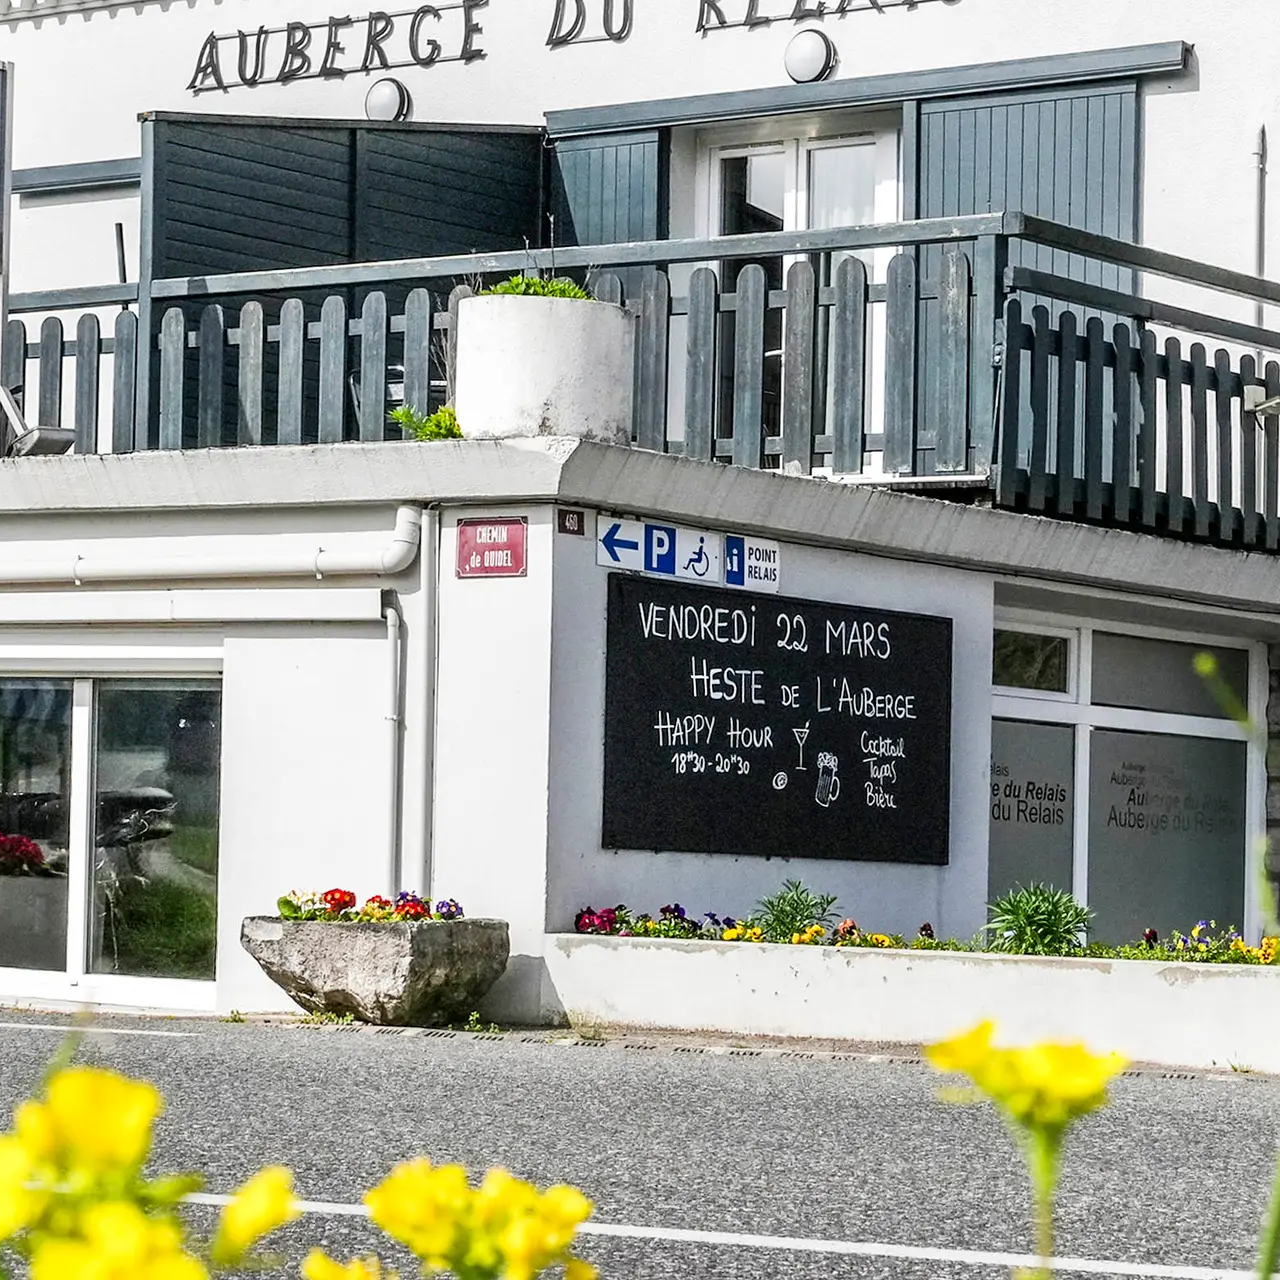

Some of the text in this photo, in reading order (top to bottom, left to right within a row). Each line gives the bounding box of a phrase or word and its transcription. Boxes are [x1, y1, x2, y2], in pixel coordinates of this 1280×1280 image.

[476, 526, 508, 543] CHEMIN
[470, 551, 481, 568] de
[748, 547, 777, 563] POINT
[748, 565, 777, 582] RELAIS
[776, 613, 808, 652] 22
[826, 620, 891, 659] MARS
[691, 656, 766, 705] HESTE
[781, 685, 800, 708] DE
[654, 710, 773, 748] HAPPY HOUR
[861, 730, 906, 757] Cocktail
[862, 757, 897, 785] Tapas
[864, 781, 897, 808] Bière
[1004, 780, 1021, 798] du
[1025, 781, 1066, 802] Relais
[992, 799, 1064, 825] du Relais
[1107, 805, 1168, 835] Auberge
